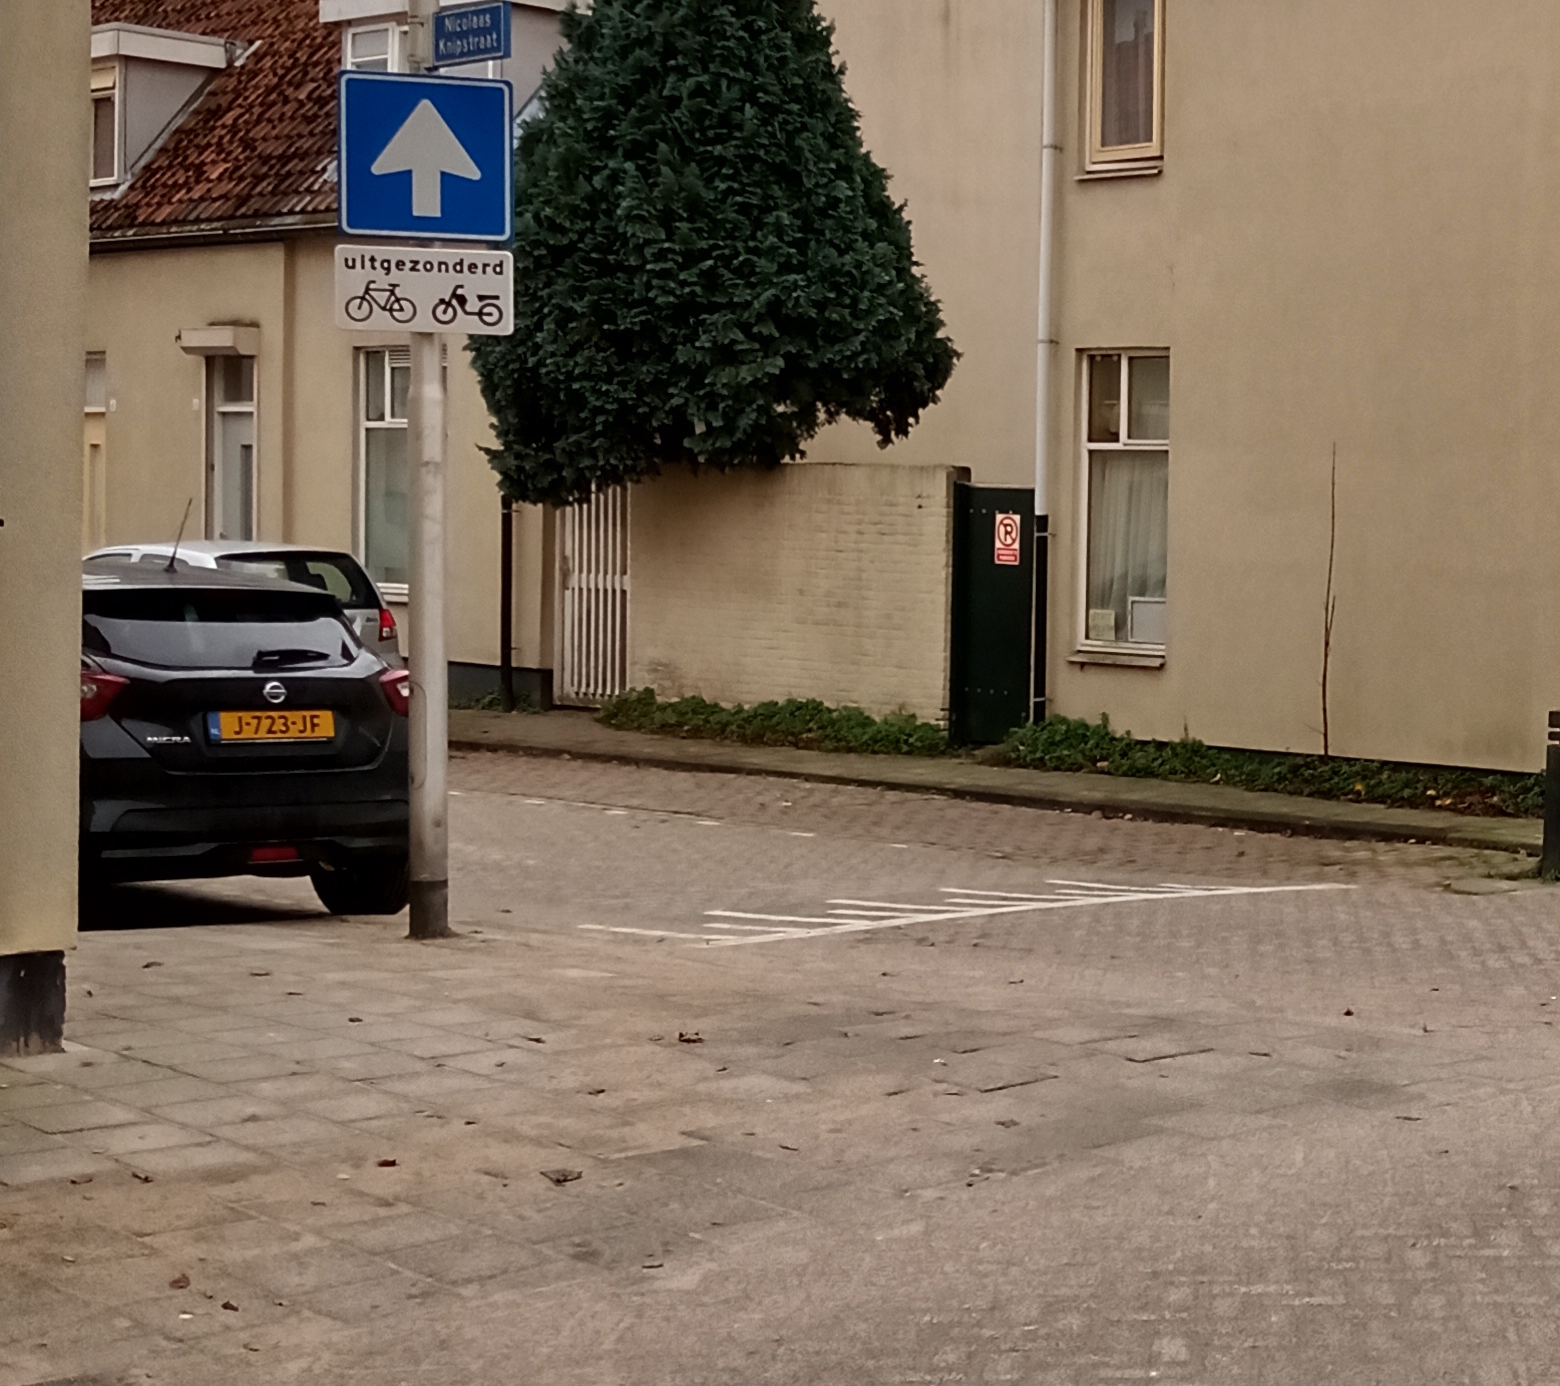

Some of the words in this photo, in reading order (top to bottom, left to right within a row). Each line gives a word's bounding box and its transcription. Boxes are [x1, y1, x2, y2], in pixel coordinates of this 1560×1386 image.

[444, 13, 491, 32] Nicolaas
[439, 31, 497, 55] Knipstraat
[344, 254, 504, 276] uitgezonderd
[233, 714, 321, 735] J-723-JF
